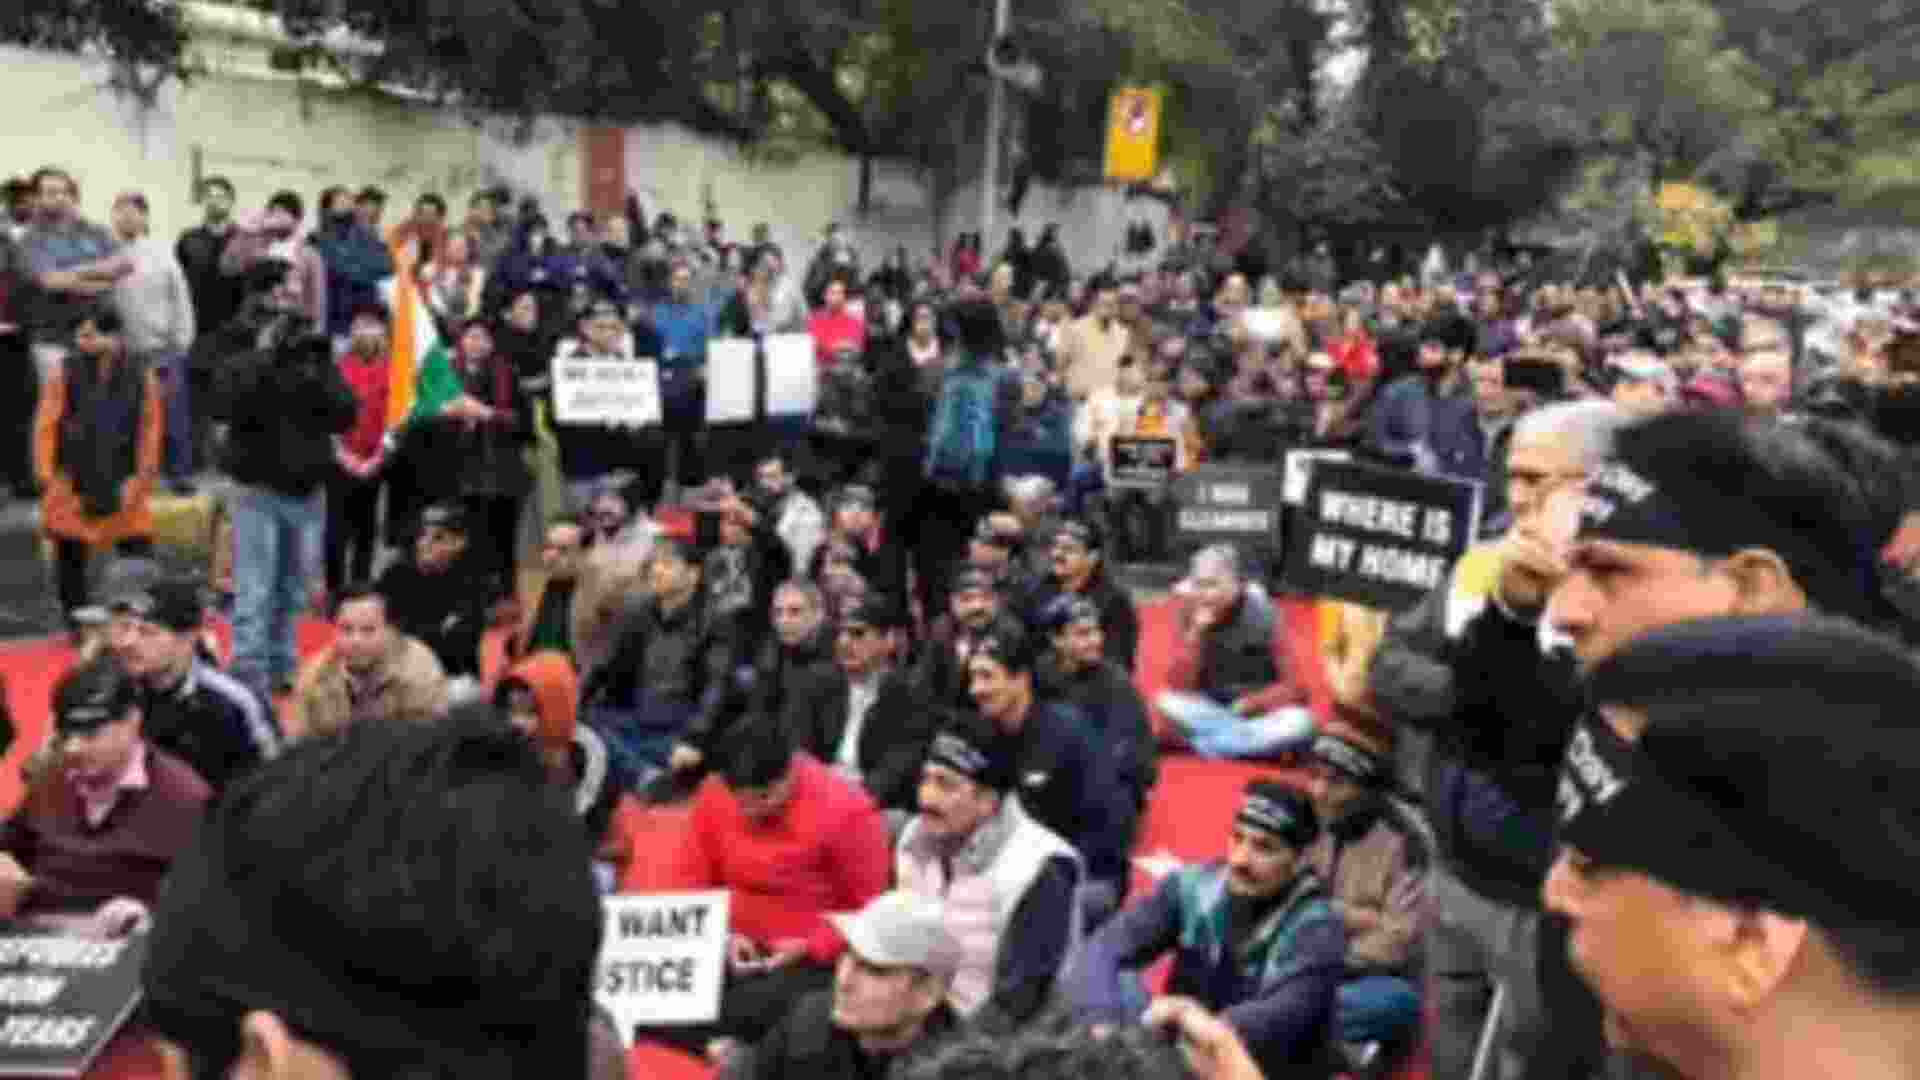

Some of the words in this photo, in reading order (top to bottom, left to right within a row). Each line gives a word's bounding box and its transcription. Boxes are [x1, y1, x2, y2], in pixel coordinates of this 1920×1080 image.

[1321, 490, 1416, 537] WHERE
[1421, 506, 1451, 544] IS
[1309, 532, 1355, 570] MY
[1359, 543, 1447, 590] HOME
[618, 903, 708, 940] WANT
[606, 957, 694, 995] STICE
